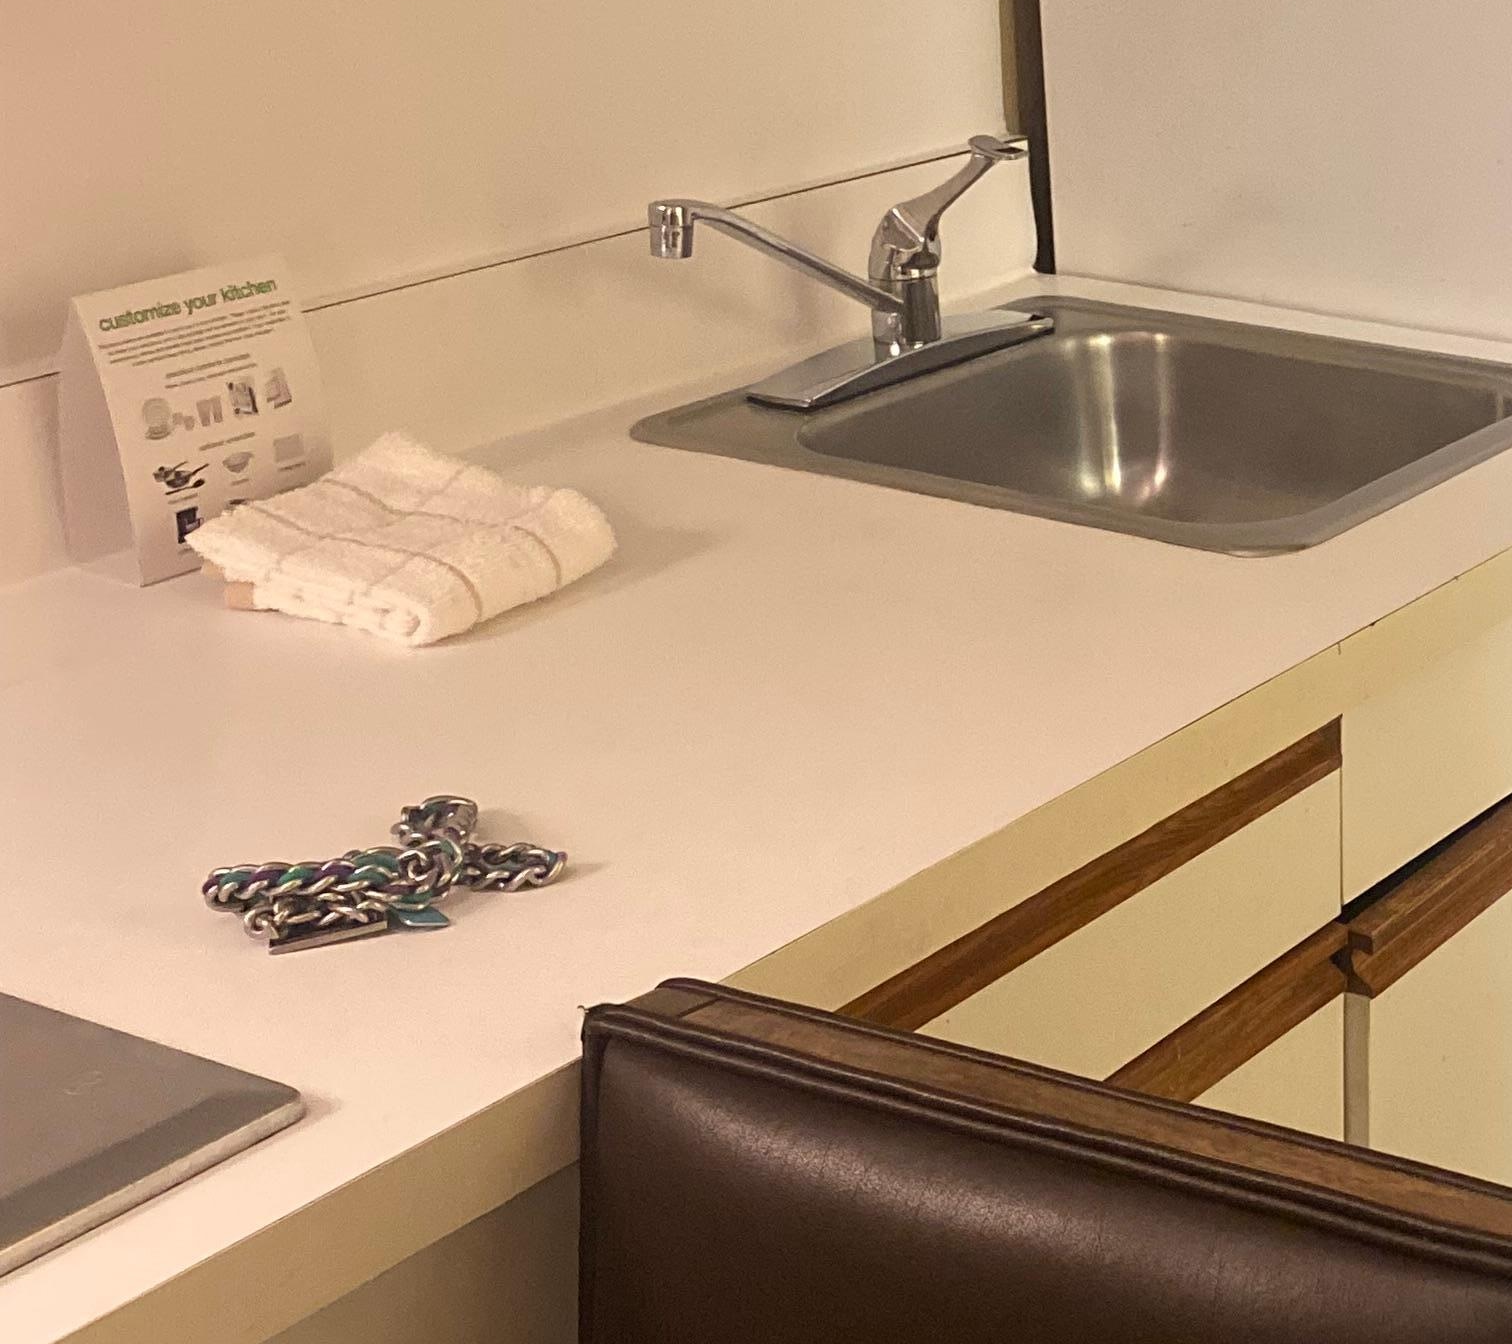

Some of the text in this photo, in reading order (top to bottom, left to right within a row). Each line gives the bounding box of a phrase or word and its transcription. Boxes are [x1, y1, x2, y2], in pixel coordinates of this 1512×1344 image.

[98, 278, 278, 333] customize your kitchen
